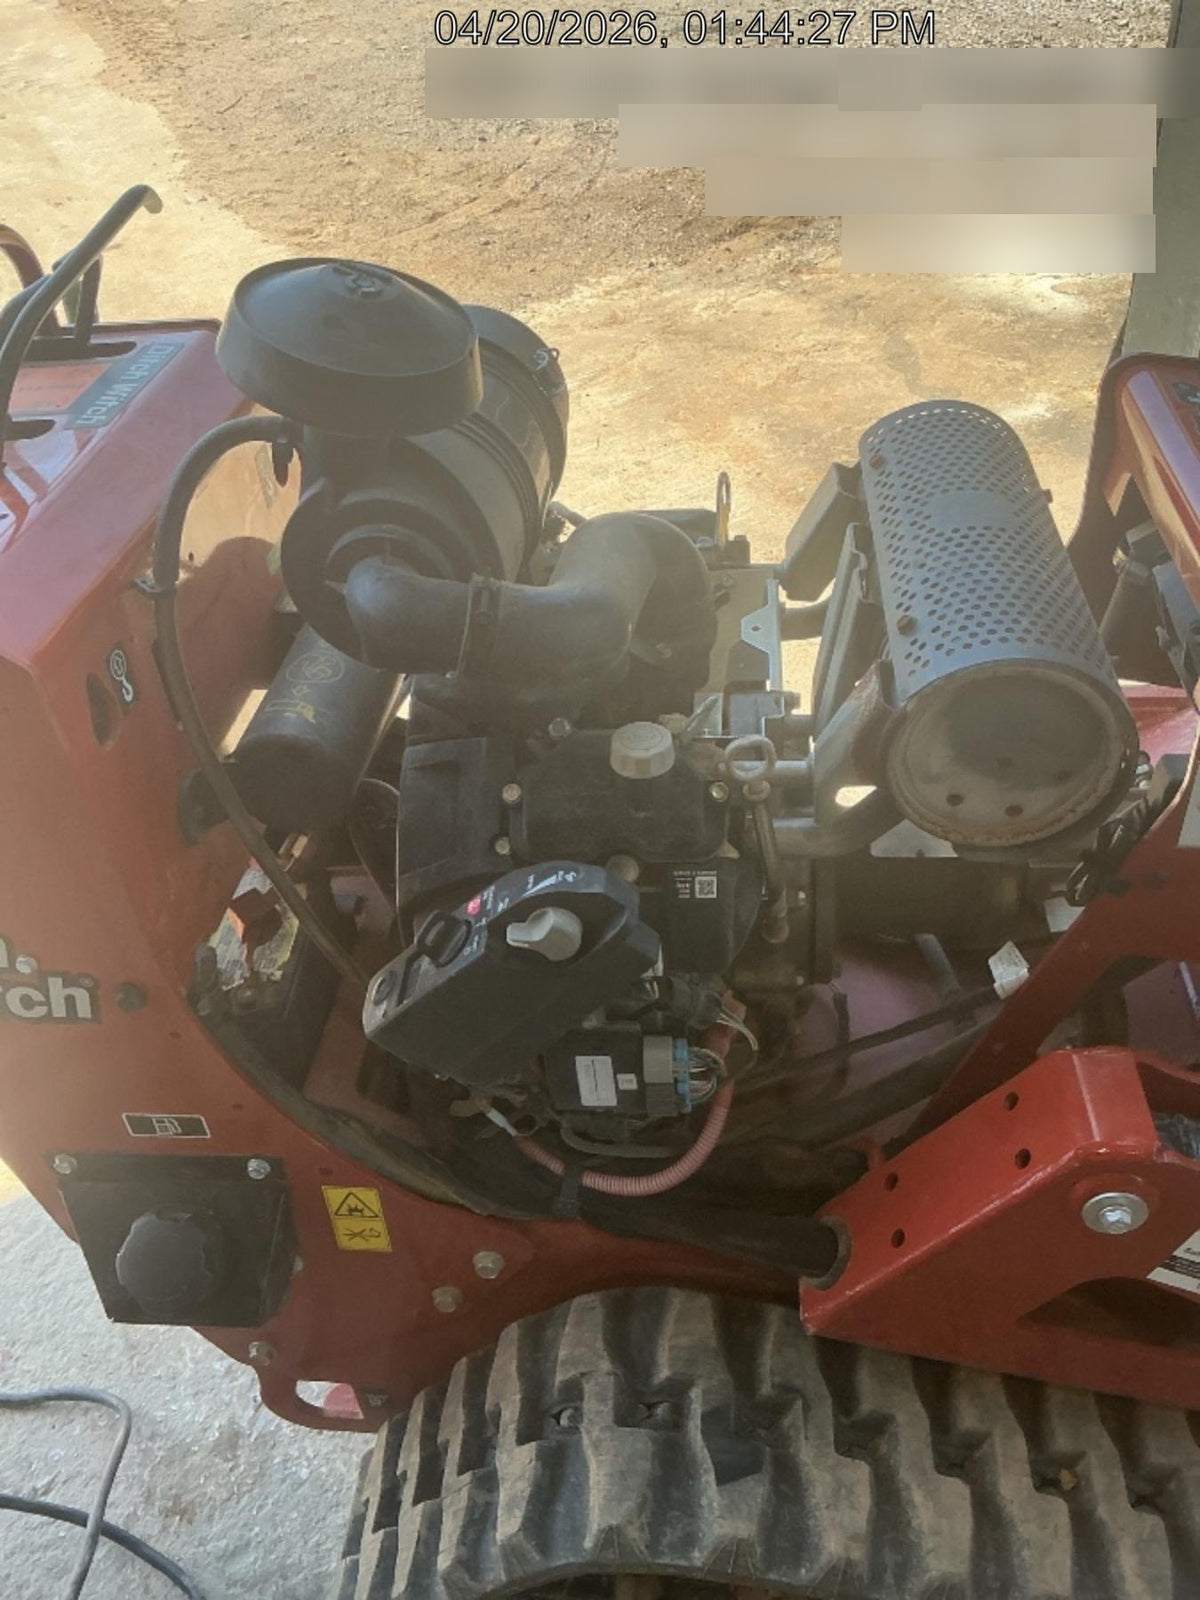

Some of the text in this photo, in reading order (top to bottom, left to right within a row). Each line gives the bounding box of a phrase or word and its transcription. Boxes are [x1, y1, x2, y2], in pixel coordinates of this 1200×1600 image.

[75, 345, 176, 424] Ditch Witch
[0, 975, 92, 1018] ch
